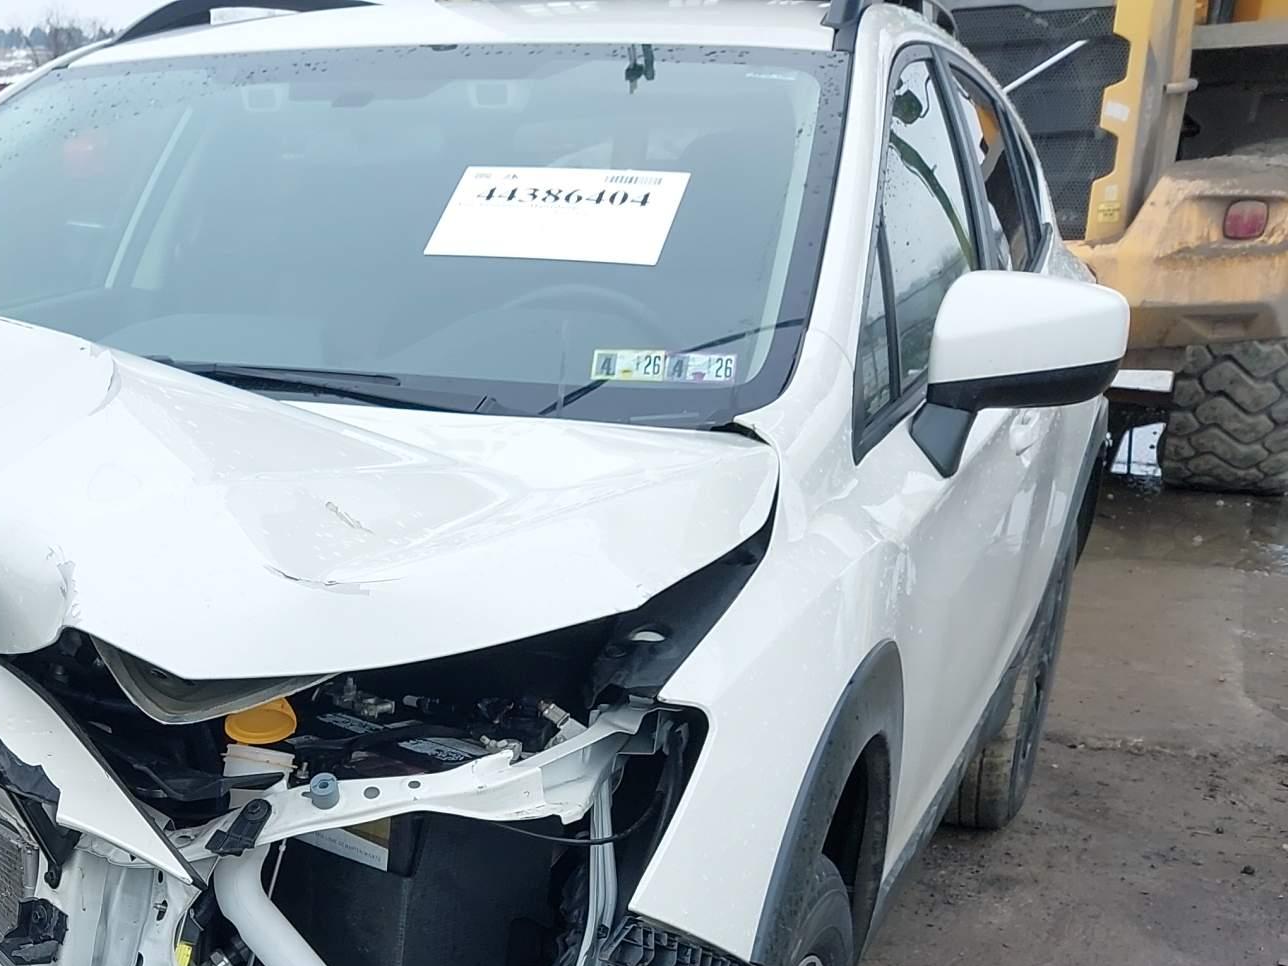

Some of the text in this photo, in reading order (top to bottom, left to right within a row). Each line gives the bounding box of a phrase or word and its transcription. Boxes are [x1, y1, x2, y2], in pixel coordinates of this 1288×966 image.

[475, 186, 652, 207] 44386404
[643, 355, 662, 376] 26
[715, 357, 734, 379] 26
